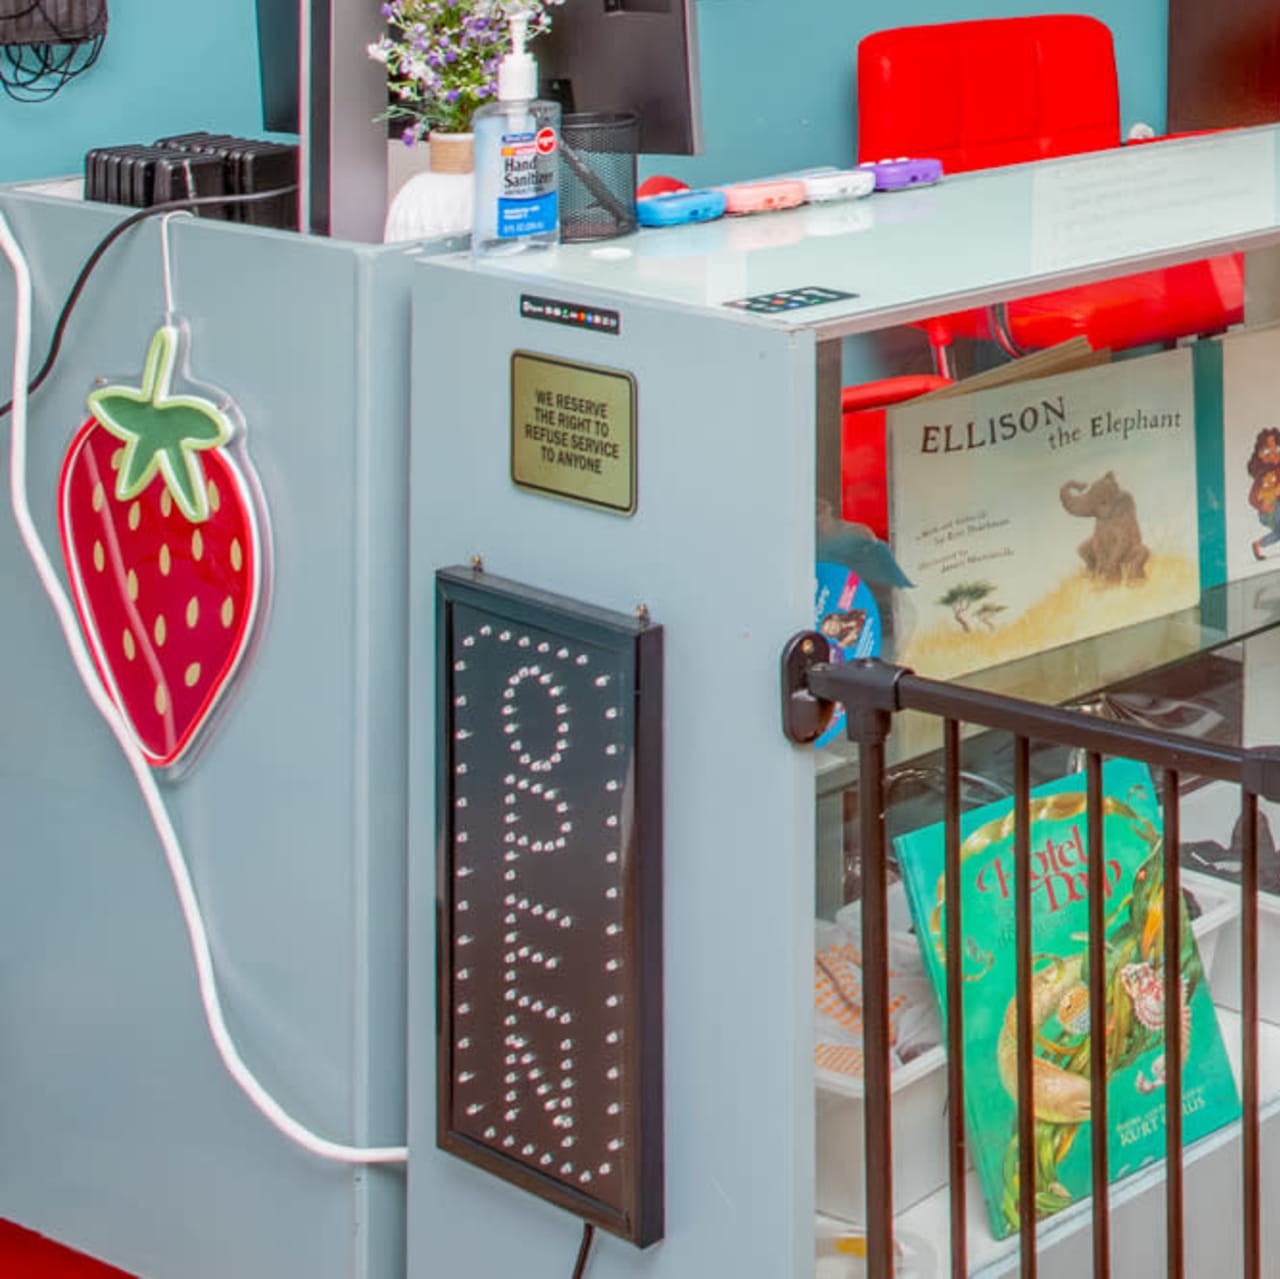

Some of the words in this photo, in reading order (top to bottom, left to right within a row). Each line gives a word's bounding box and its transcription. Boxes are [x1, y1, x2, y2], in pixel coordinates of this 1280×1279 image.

[505, 155, 538, 172] Hand
[534, 387, 554, 408] WE
[556, 393, 609, 420] RESERVE
[533, 406, 555, 427] THE
[557, 412, 592, 434] RIGHT
[595, 420, 610, 439] TO
[921, 395, 1069, 455] ELLISON
[1048, 425, 1082, 451] the
[1090, 408, 1182, 440] Elephant
[524, 423, 569, 448] REFUSE
[570, 433, 621, 460] SERVICE
[540, 445, 555, 463] TO
[556, 451, 603, 475] ANYONE
[502, 666, 573, 1153] OPEN
